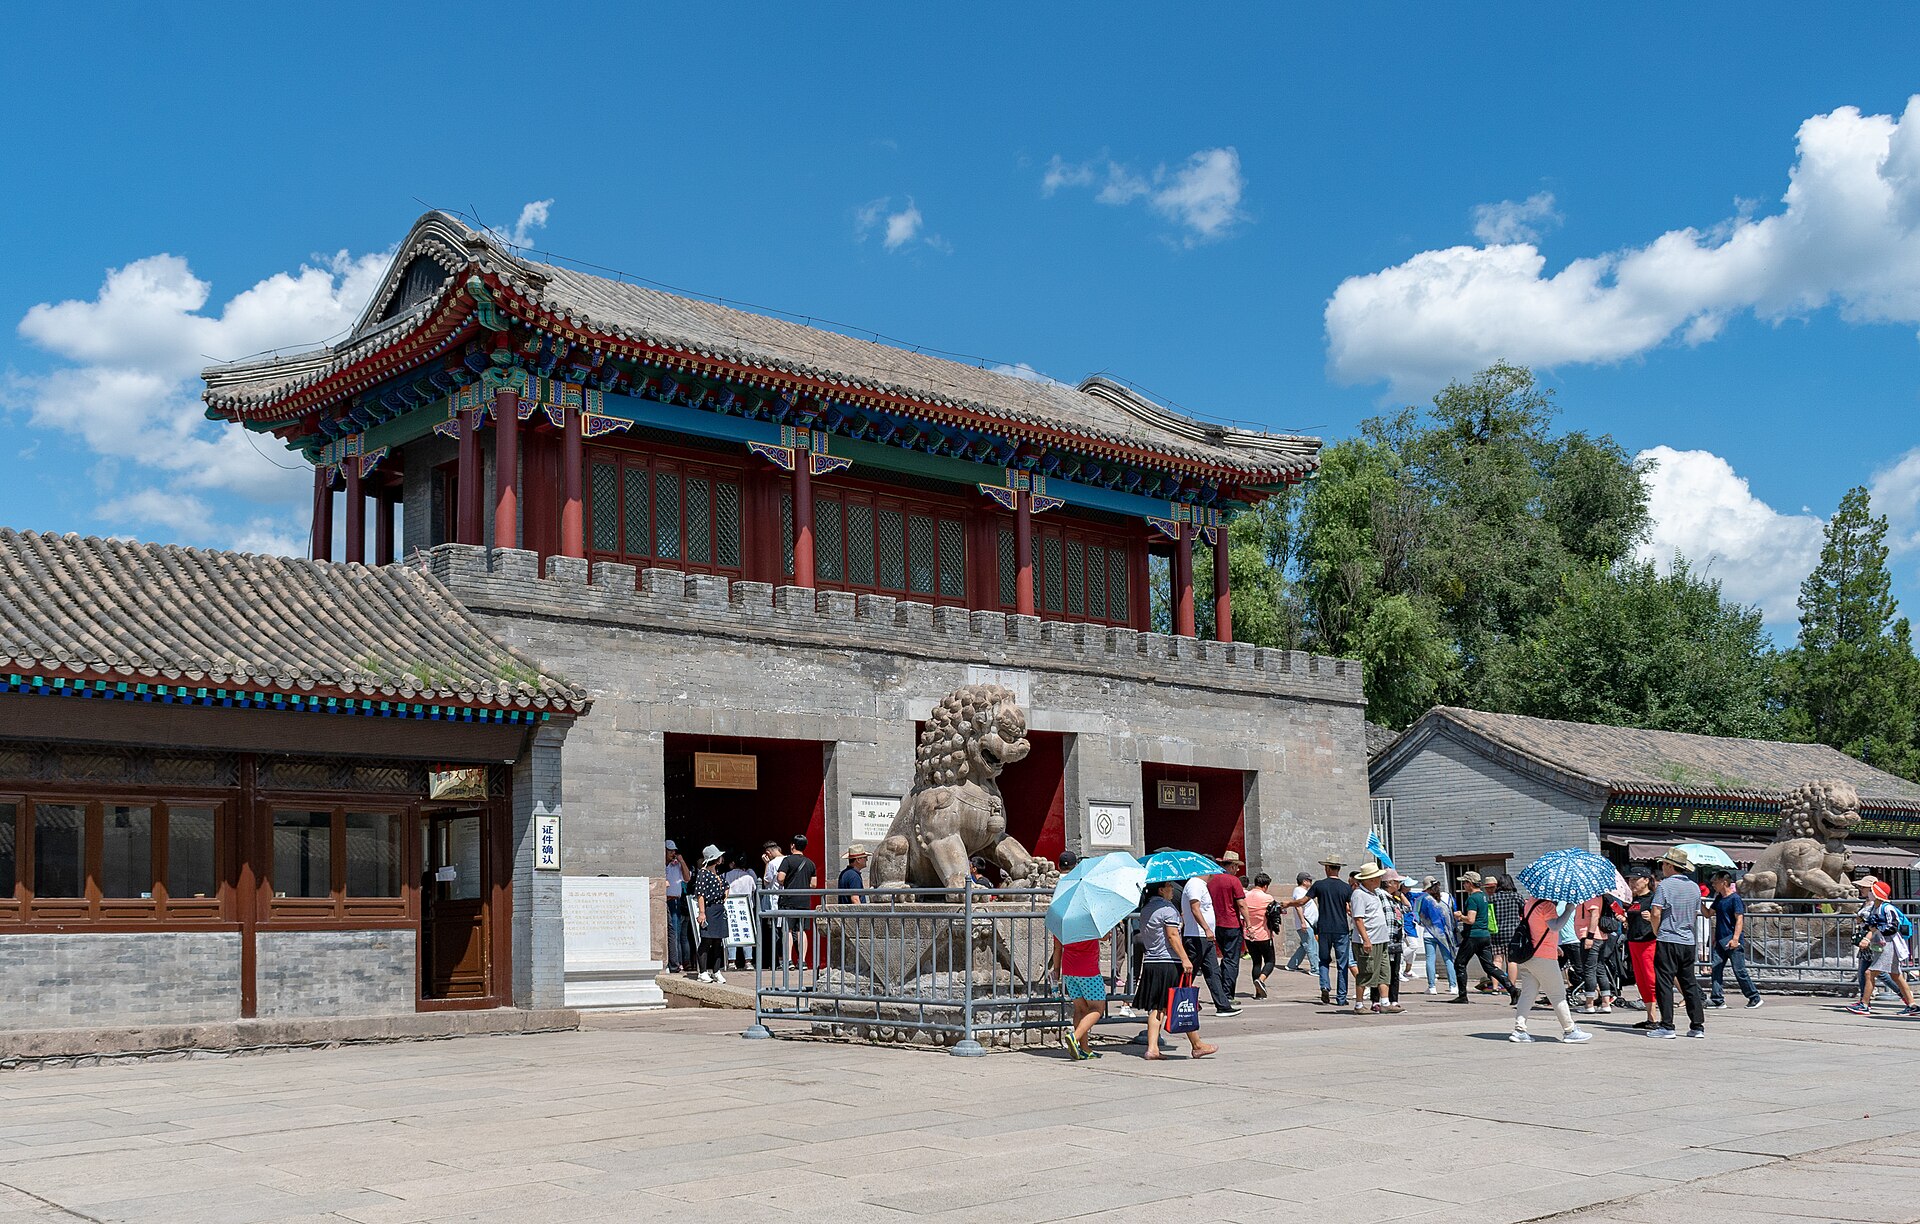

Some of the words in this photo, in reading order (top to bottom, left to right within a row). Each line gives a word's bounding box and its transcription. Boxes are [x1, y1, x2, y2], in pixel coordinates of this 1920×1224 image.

[1179, 786, 1195, 797] 出口
[541, 824, 554, 865] 证件确认
